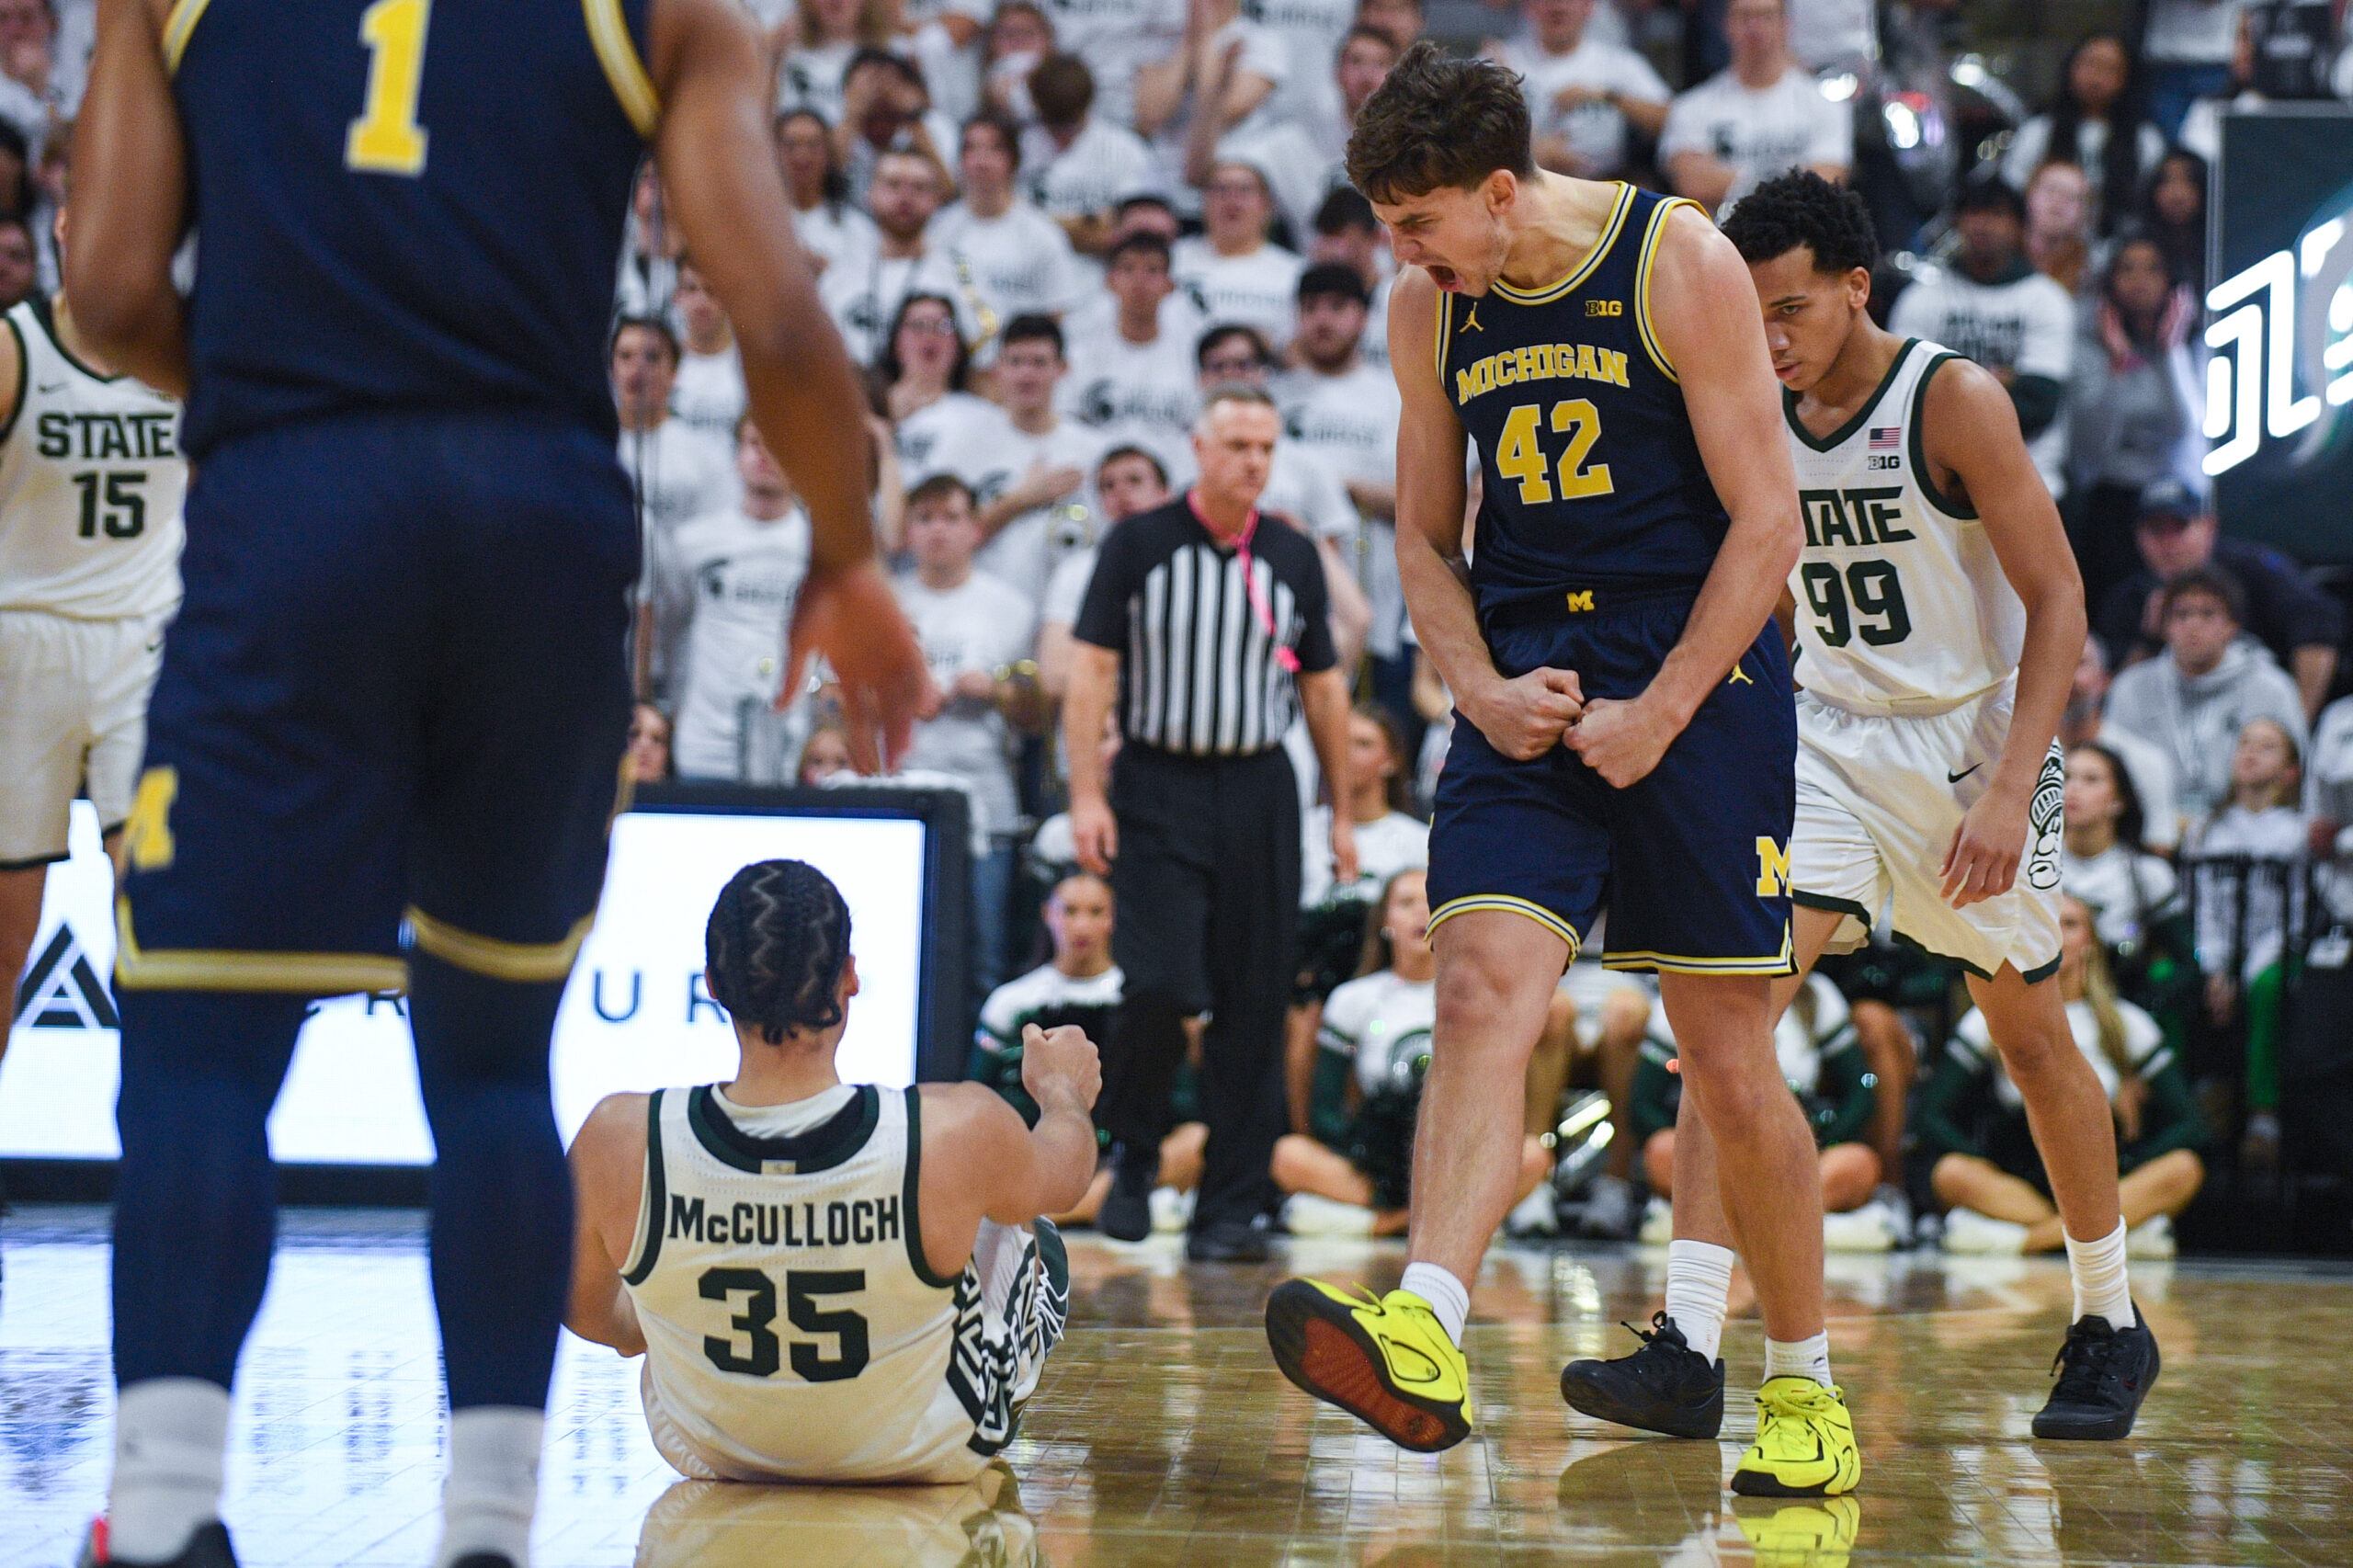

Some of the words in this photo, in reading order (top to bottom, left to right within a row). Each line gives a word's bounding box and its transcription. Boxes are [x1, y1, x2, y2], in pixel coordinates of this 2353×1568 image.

[345, 0, 432, 175] 1
[1456, 344, 1630, 405] MICHIGAN
[38, 413, 176, 459] STATE
[1495, 398, 1614, 505] 42
[72, 470, 148, 539] 15
[1799, 486, 1916, 546] TATE
[1567, 590, 1595, 612] M
[1801, 558, 1913, 648] 99
[668, 1194, 899, 1247] McCULLOCH
[698, 1267, 870, 1382] 35
